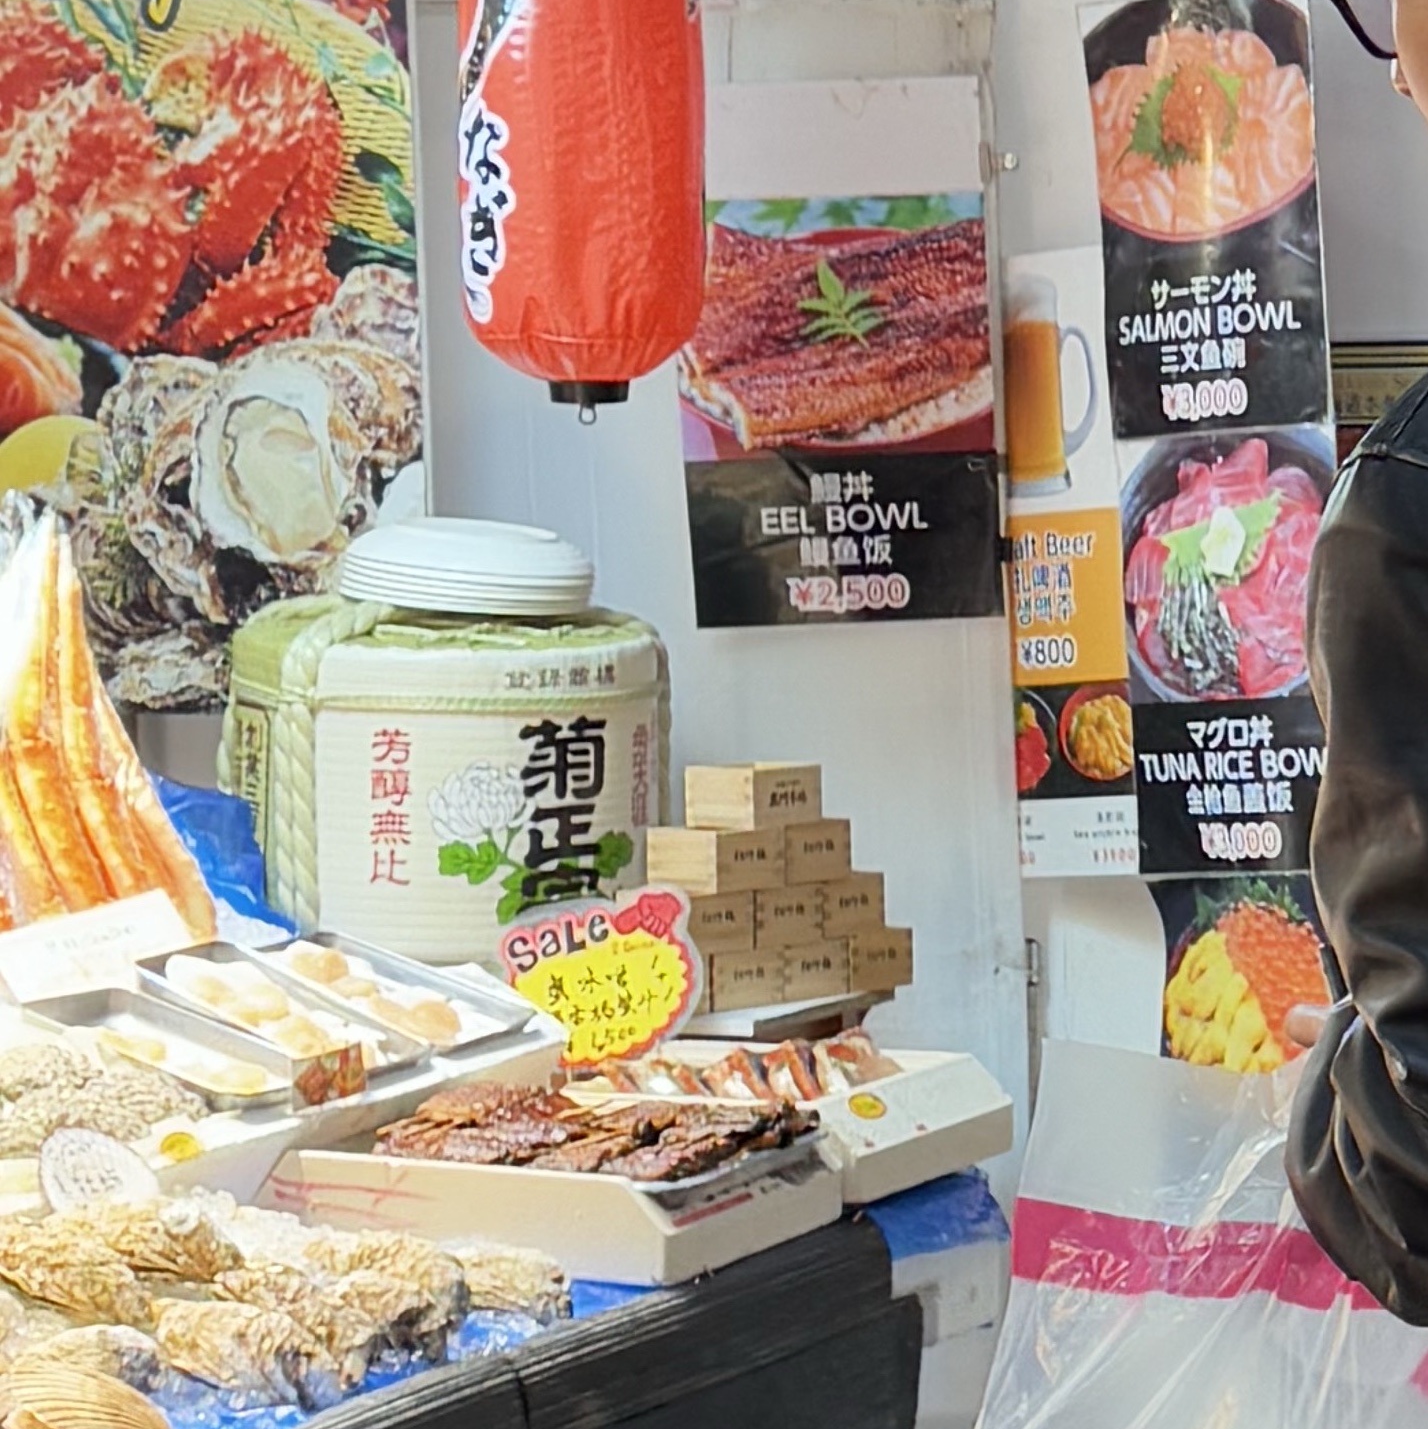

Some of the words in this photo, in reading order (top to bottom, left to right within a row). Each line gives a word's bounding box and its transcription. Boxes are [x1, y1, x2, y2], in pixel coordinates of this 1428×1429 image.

[1150, 267, 1257, 310] サーモン丼
[1118, 306, 1211, 347] SALMON
[1216, 300, 1302, 336] BOWL
[760, 504, 816, 536] EEL
[825, 502, 929, 534] BOWL
[1045, 531, 1094, 558] Beer
[786, 573, 911, 614] ¥2,500
[1020, 637, 1076, 665] ¥800
[1185, 713, 1274, 750] マグロ丼
[1138, 751, 1203, 783] TUNA
[1203, 749, 1256, 782] RICE
[1259, 746, 1329, 780] BOW
